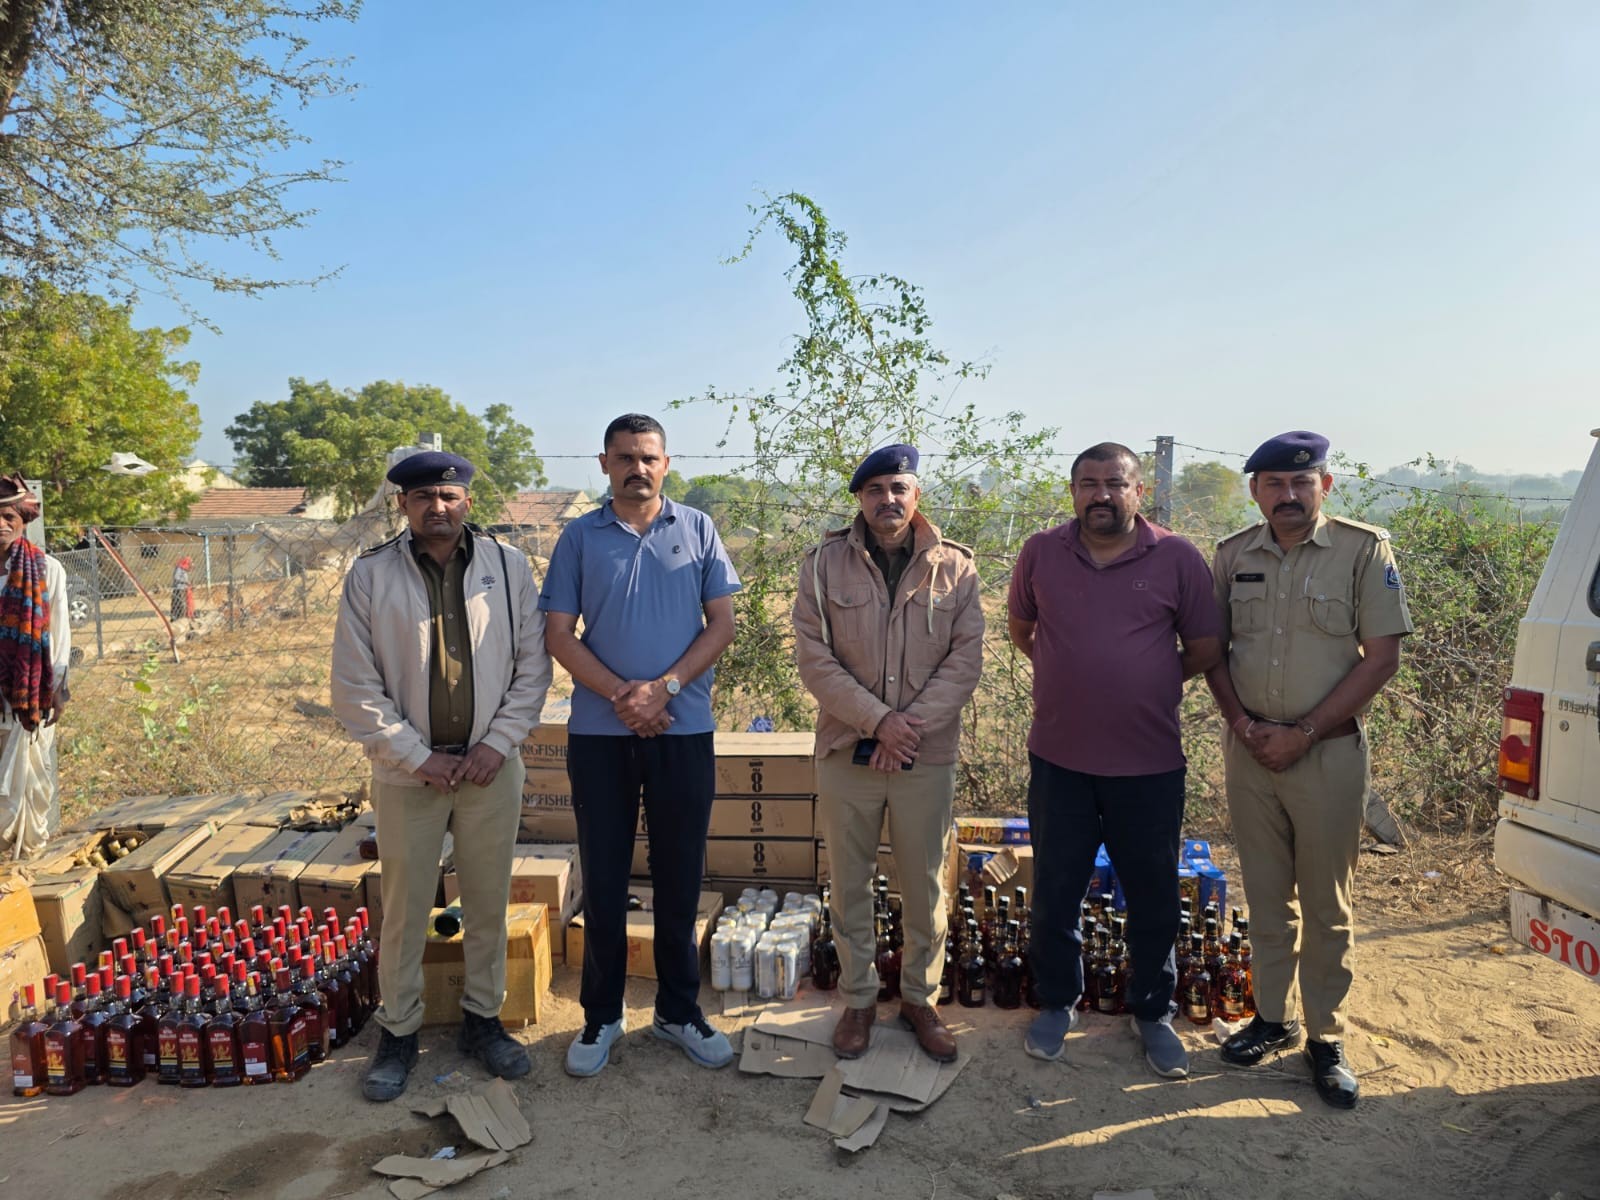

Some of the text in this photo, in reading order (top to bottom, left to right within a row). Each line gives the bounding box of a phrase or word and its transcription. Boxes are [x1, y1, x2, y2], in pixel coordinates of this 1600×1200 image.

[519, 743, 568, 758] INGFISHE
[521, 792, 573, 807] NGFISHE
[751, 801, 762, 822] 8
[753, 842, 765, 863] 8
[1529, 918, 1600, 977] STO
